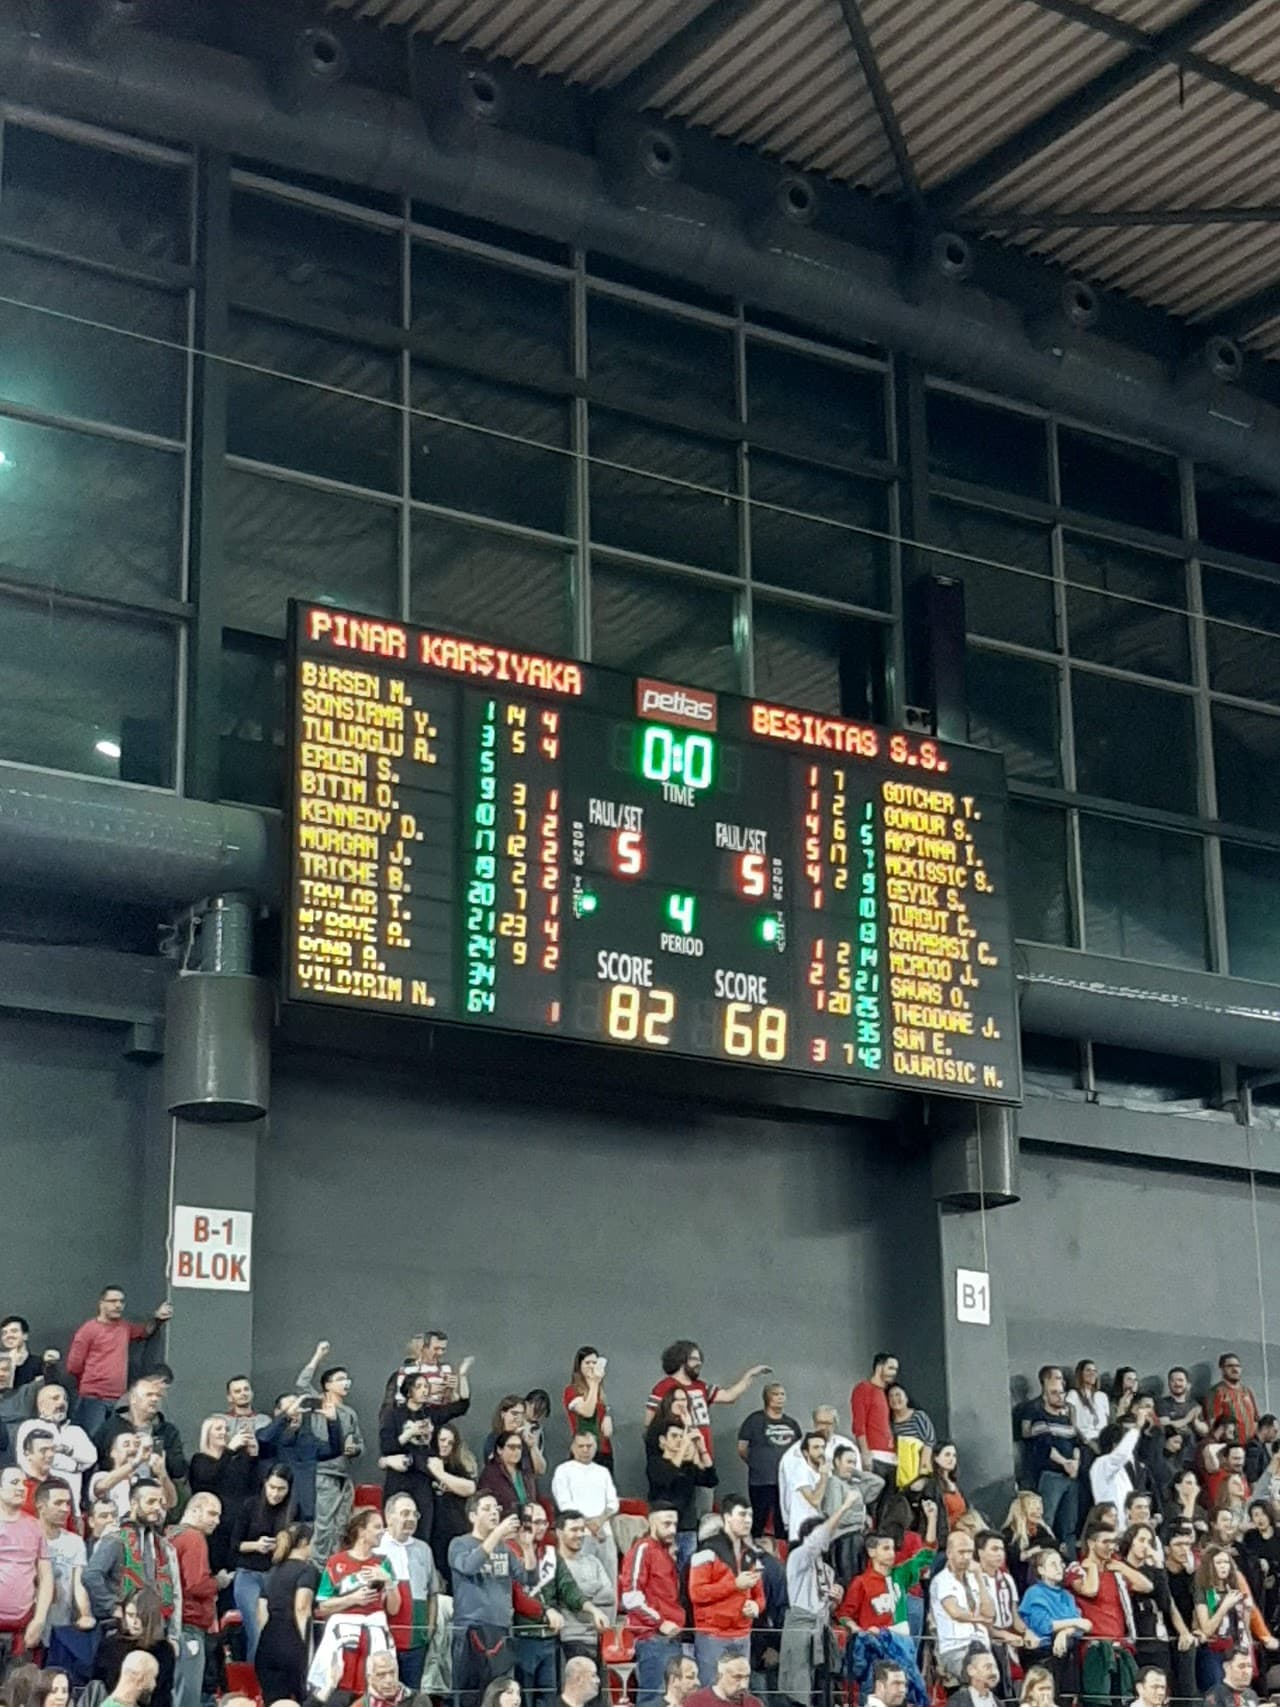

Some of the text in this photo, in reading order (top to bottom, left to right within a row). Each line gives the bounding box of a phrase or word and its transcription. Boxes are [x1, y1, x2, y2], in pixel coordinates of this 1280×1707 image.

[308, 610, 407, 659] PINAR
[389, 679, 413, 706] M.
[487, 701, 496, 721] 1
[507, 704, 526, 728] 14
[542, 711, 558, 733] 4
[413, 710, 438, 737] Y.
[480, 724, 495, 748] 3
[512, 730, 526, 753] 5
[542, 737, 558, 759] 4
[751, 705, 879, 758] BESIKTAS
[301, 742, 559, 811] ERDEN S. 9 3 1
[413, 737, 437, 764] A.
[480, 750, 495, 773] 5
[642, 726, 713, 789] 0:0
[301, 769, 367, 803] BITIM
[475, 802, 496, 826] 10
[513, 808, 527, 831] 7
[543, 814, 559, 837] 2
[661, 780, 696, 807] TIME
[810, 765, 818, 787] 1
[833, 770, 845, 791] 7
[961, 797, 982, 820] T.
[300, 797, 391, 834] KENNEDY
[400, 814, 423, 840] D.
[543, 840, 559, 864] 2
[588, 798, 643, 834] FAUL/SET
[805, 814, 820, 835] 4
[833, 819, 847, 841] 6
[860, 824, 874, 846] 5
[810, 790, 819, 811] 1
[832, 794, 846, 816] 2
[865, 801, 873, 821] 1
[952, 819, 972, 842] S.
[300, 823, 379, 860] MORGAN
[389, 840, 412, 866] J.
[511, 861, 528, 884] 2
[543, 866, 559, 890] 2
[617, 831, 643, 874] 5
[715, 822, 767, 857] FAUL/SET
[299, 851, 379, 887] TRICHE
[388, 865, 411, 893] B.
[514, 887, 527, 910] 7
[550, 894, 560, 916] 1
[741, 854, 765, 896] 5
[805, 837, 820, 860] 5
[862, 848, 875, 869] 7
[974, 871, 994, 893] S.
[806, 861, 821, 885] 4
[834, 868, 848, 890] 2
[862, 873, 876, 895] 9
[946, 889, 966, 912] S.
[388, 893, 411, 920] T.
[468, 907, 496, 932] 21
[499, 912, 527, 937] 23
[543, 919, 559, 942] 4
[669, 894, 694, 934] 4
[813, 888, 823, 910] 1
[957, 914, 977, 938] C.
[468, 934, 496, 959] 24
[512, 941, 527, 965] 9
[543, 945, 559, 970] 2
[660, 932, 704, 957] PERIOD
[815, 938, 824, 960] 1
[836, 941, 851, 965] 2
[860, 946, 878, 968] 14
[960, 964, 979, 987] J.
[977, 942, 998, 966] C.
[597, 950, 653, 987] SCORE
[714, 968, 768, 1005] SCORE
[809, 961, 824, 986] 2
[838, 967, 851, 990] 5
[855, 970, 879, 993] 21
[411, 980, 436, 1006] N.
[467, 988, 496, 1012] 64
[550, 1001, 561, 1023] 1
[608, 984, 676, 1045] 82
[816, 989, 826, 1011] 1
[827, 991, 852, 1016] 20
[892, 1001, 974, 1035] THEODORE
[982, 1017, 1001, 1038] J.
[723, 1001, 787, 1061] 68
[932, 1032, 952, 1056] E.
[812, 1038, 827, 1063] 3
[842, 1043, 854, 1065] 7
[857, 1046, 882, 1071] 42
[193, 1215, 234, 1246] B-1
[177, 1250, 248, 1283] BLOK
[962, 1283, 987, 1312] B1
